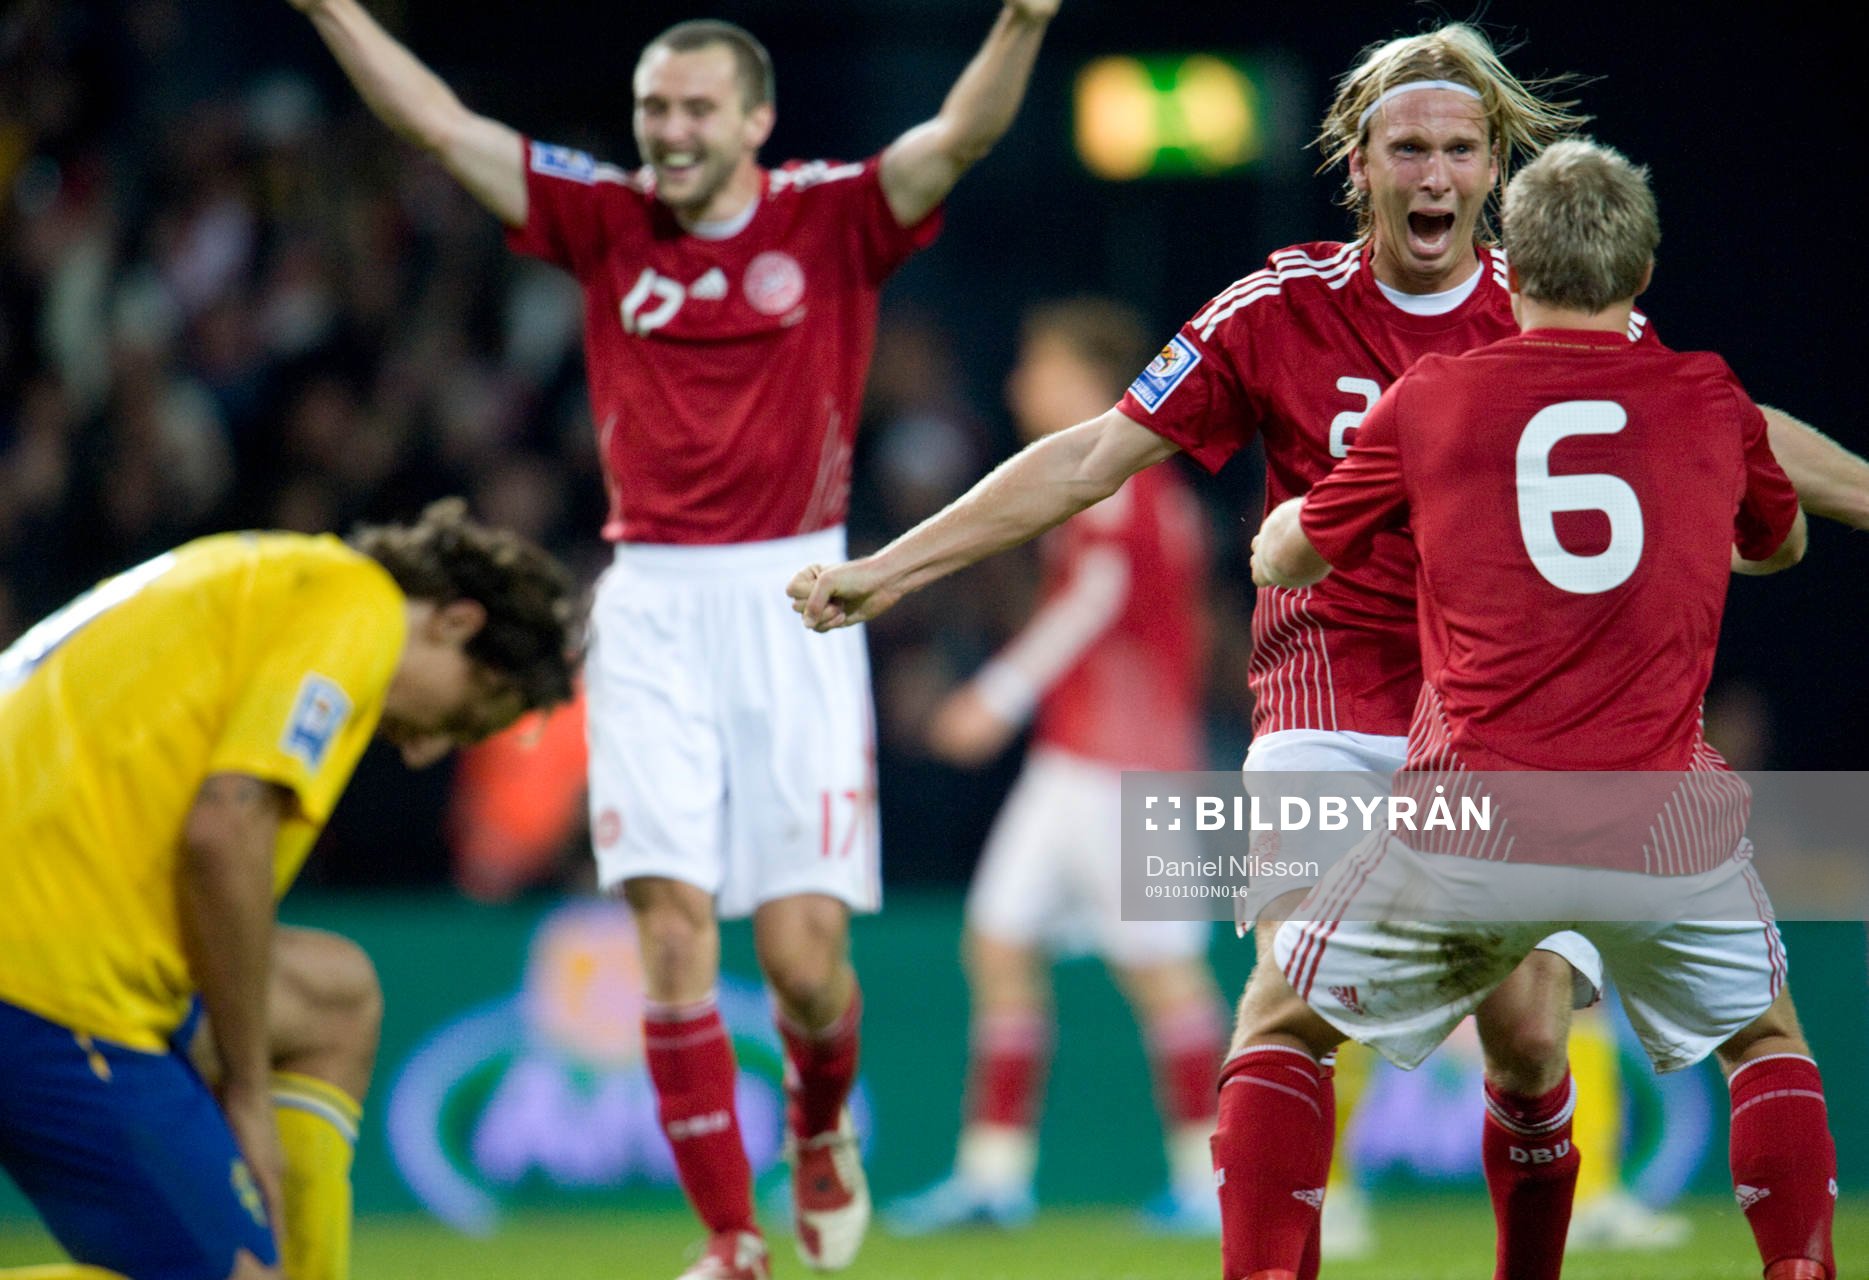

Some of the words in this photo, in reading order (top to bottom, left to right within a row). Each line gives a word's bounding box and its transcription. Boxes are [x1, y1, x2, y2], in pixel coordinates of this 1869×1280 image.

[1328, 376, 1381, 458] 2
[1516, 400, 1644, 594] 6
[820, 790, 860, 859] 17
[1509, 1138, 1570, 1164] DBU
